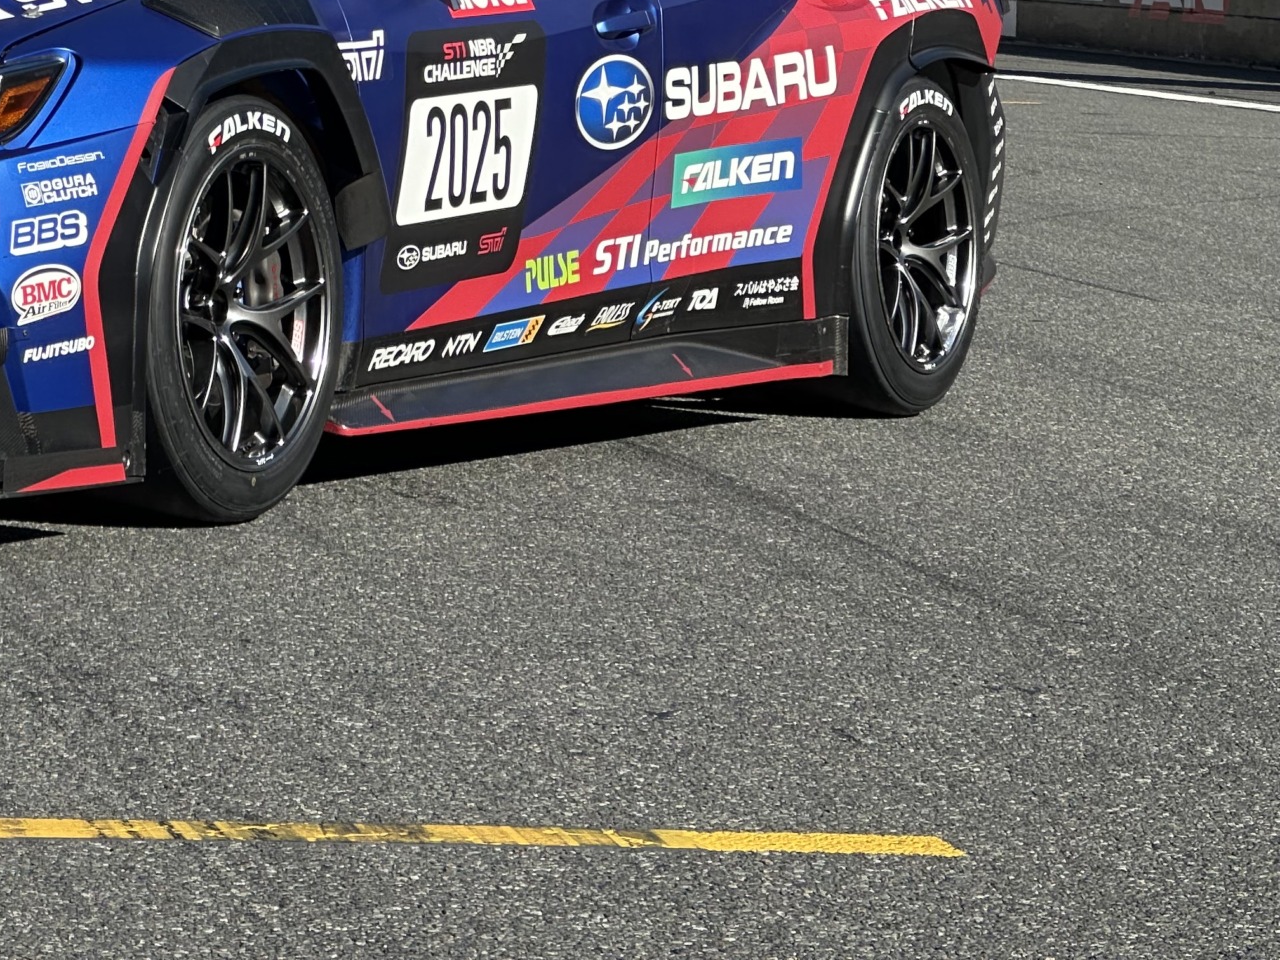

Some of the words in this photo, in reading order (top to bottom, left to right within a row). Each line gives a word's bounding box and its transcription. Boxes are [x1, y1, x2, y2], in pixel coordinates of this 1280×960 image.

[443, 41, 466, 60] STI
[468, 38, 496, 57] NBR
[423, 58, 496, 83] CHALLENGE
[664, 45, 838, 121] SUBARU
[899, 88, 953, 120] FALKEN
[208, 110, 291, 155] FALKEN
[424, 98, 513, 212] 2025
[41, 173, 96, 192] OGURA
[681, 149, 795, 194] FALKEN
[43, 184, 98, 203] CLUTCH
[11, 210, 88, 256] BBS
[422, 240, 468, 262] SUBARU
[593, 233, 642, 275] STI
[643, 223, 793, 266] Performance
[525, 249, 580, 293] PULSE
[20, 277, 73, 306] BMC
[23, 304, 47, 319] Air
[48, 300, 70, 312] Filter
[23, 336, 95, 363] FUJITSUBO
[441, 331, 483, 358] NTN
[491, 327, 523, 343] BILSTEIN
[367, 339, 435, 372] RECARO
